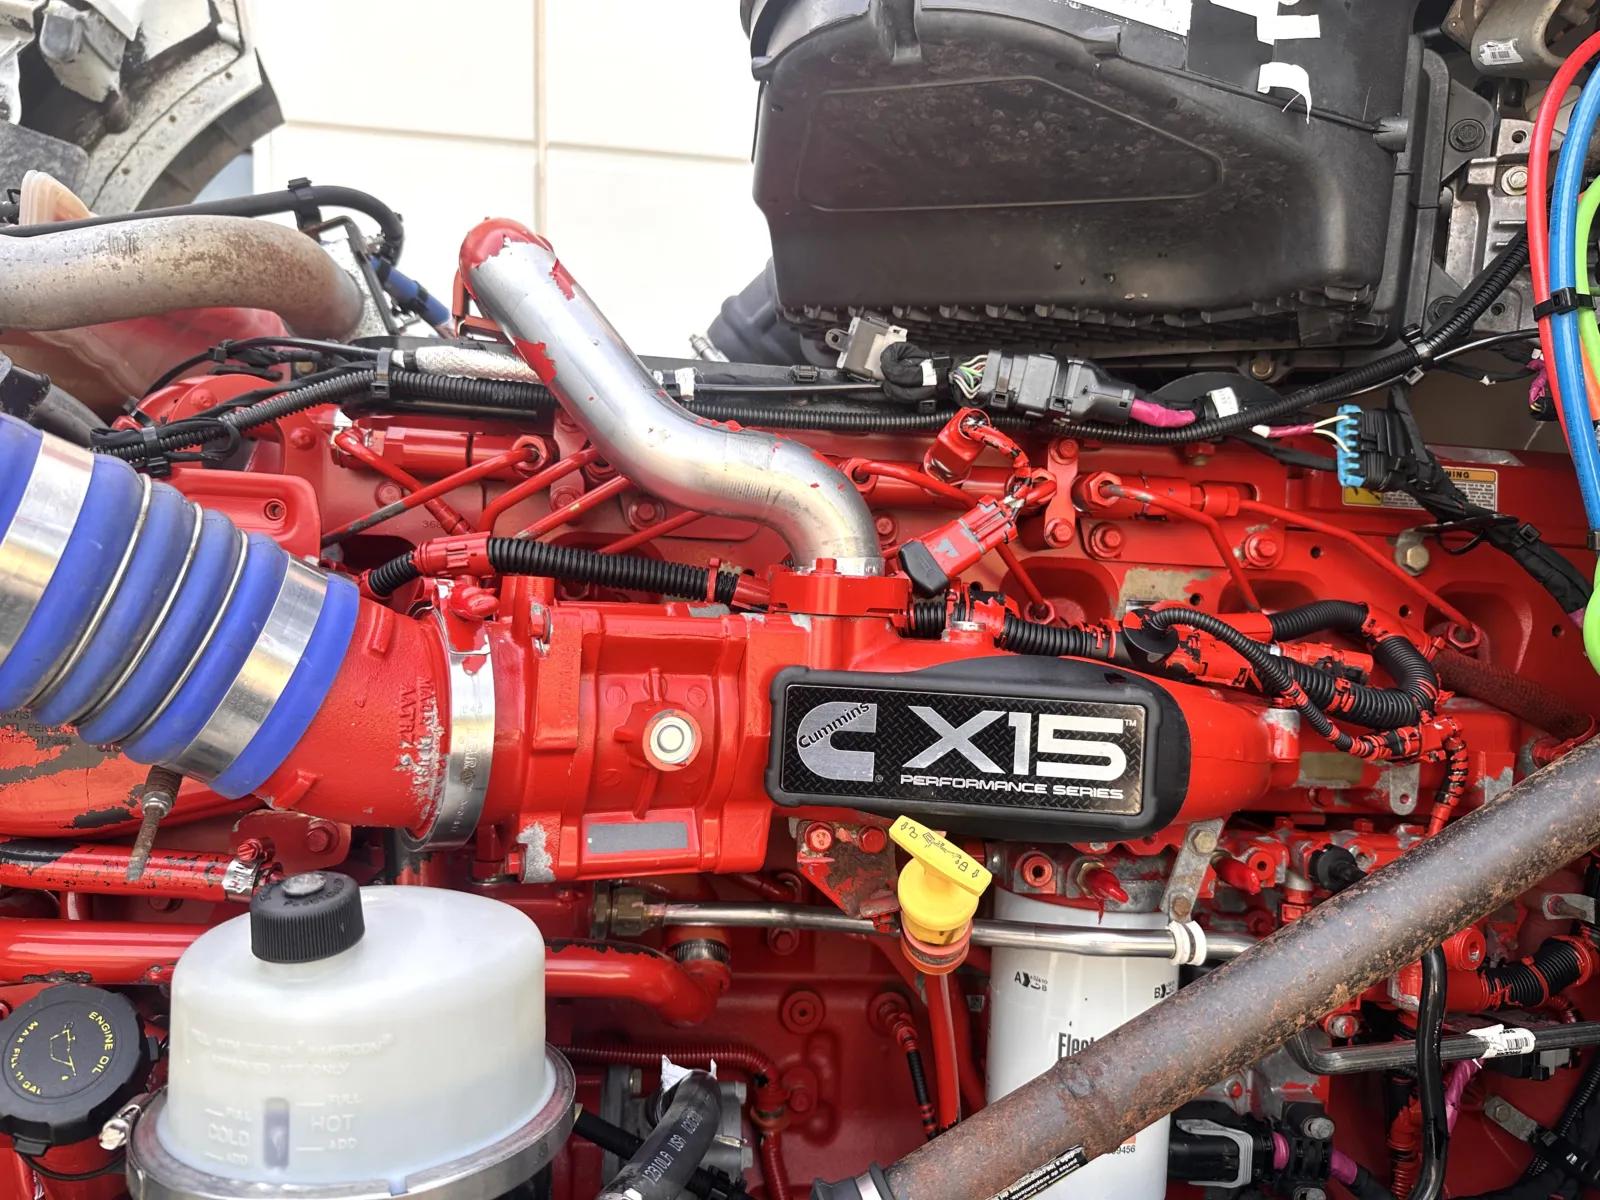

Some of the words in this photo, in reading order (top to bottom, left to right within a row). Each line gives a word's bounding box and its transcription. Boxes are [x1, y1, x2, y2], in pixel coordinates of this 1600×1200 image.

[1446, 470, 1470, 479] NING
[798, 701, 870, 750] Cummins
[902, 705, 1127, 782] X15
[900, 774, 1048, 795] PERFORMANCE
[1053, 785, 1123, 799] SERIES
[1014, 971, 1022, 983] A
[1154, 987, 1161, 999] B
[16, 1021, 39, 1043] MAX
[88, 1011, 114, 1051] ENGINE
[10, 1047, 21, 1069] FILL
[92, 1055, 110, 1074] OIL
[22, 1080, 42, 1095] GAL
[311, 1113, 357, 1133] HOT
[208, 1122, 250, 1147] COLD
[327, 1137, 360, 1150] ADD
[668, 1134, 687, 1152] USA
[1108, 1145, 1136, 1155] 9456
